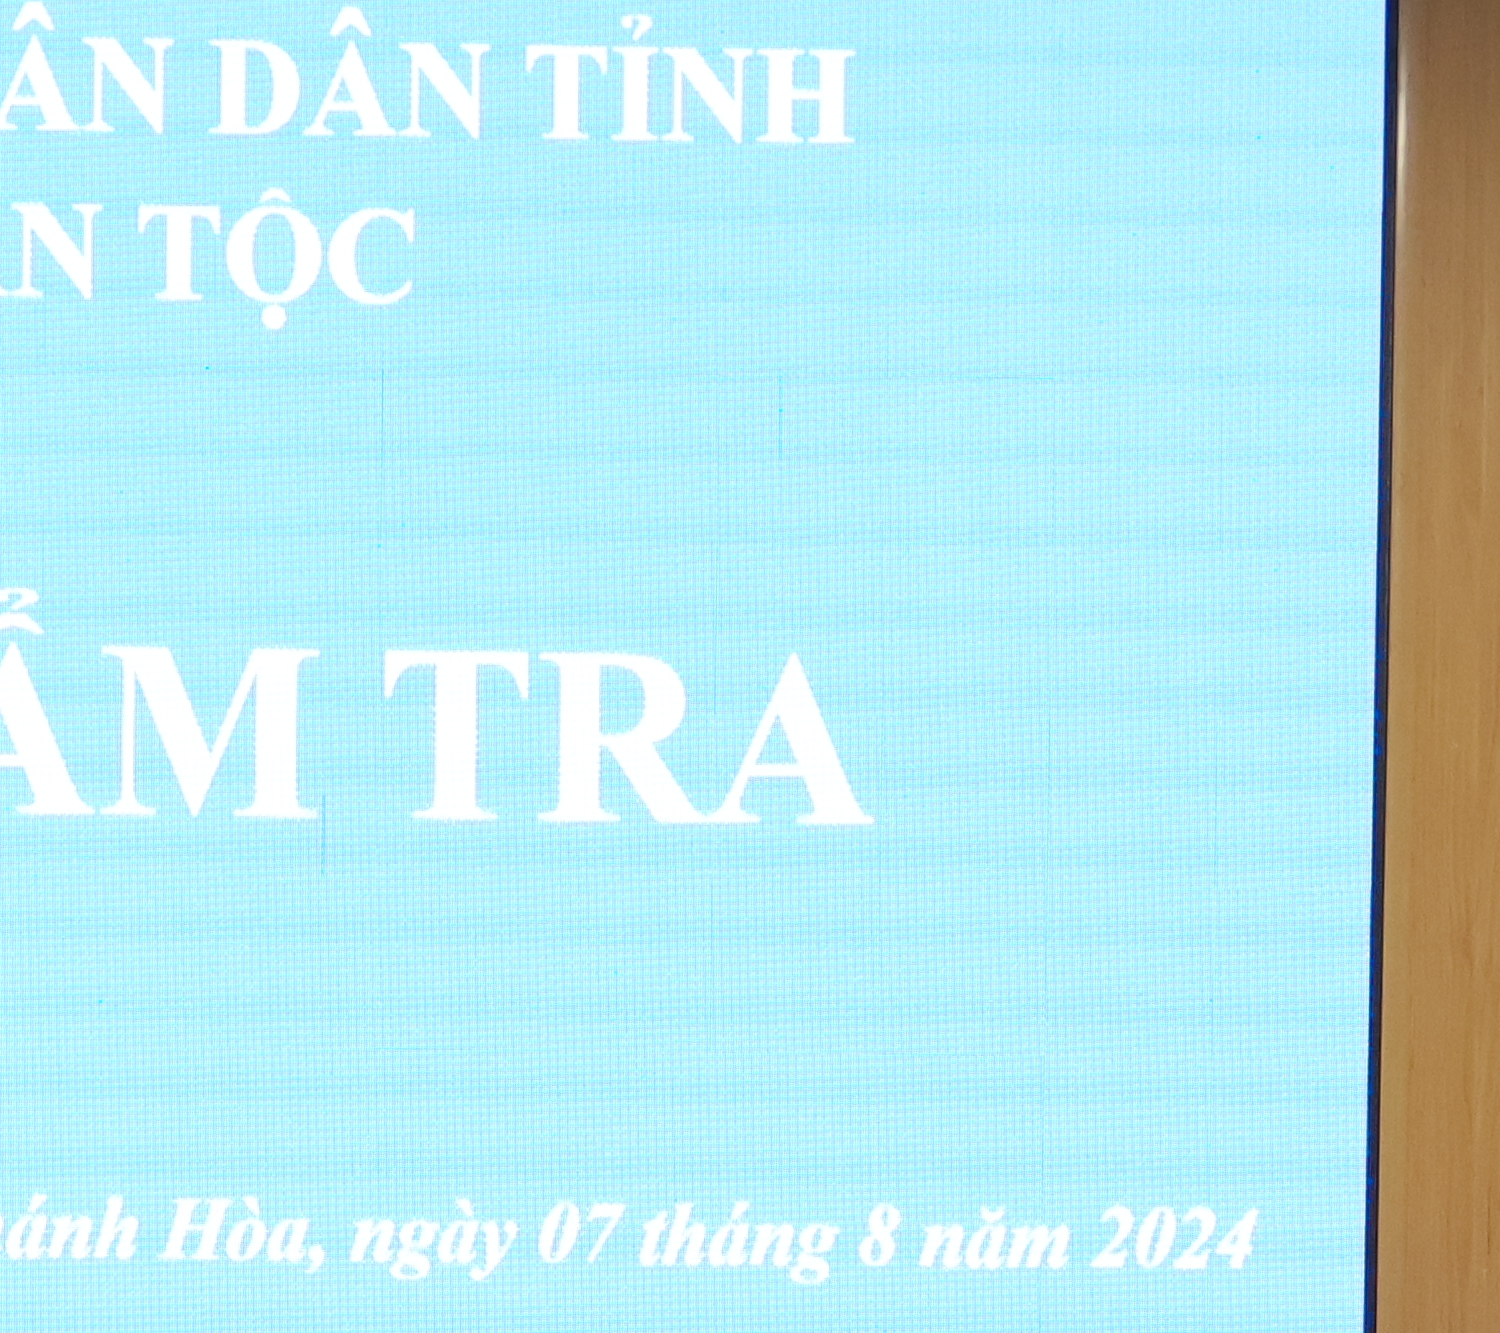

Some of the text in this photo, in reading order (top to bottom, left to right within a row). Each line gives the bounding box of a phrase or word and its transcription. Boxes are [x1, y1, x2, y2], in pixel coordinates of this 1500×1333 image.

[209, 6, 492, 138] DÂN
[526, 14, 856, 144] TỈNH
[138, 187, 417, 331] TỘC
[382, 648, 875, 827] TRA
[161, 1196, 327, 1272] Hòa,
[350, 1198, 519, 1281] ngày
[537, 1202, 626, 1264] 07
[639, 1200, 840, 1284] tháng
[859, 1204, 902, 1267] 8
[919, 1207, 1071, 1271] năm
[1090, 1204, 1260, 1271] 2024
